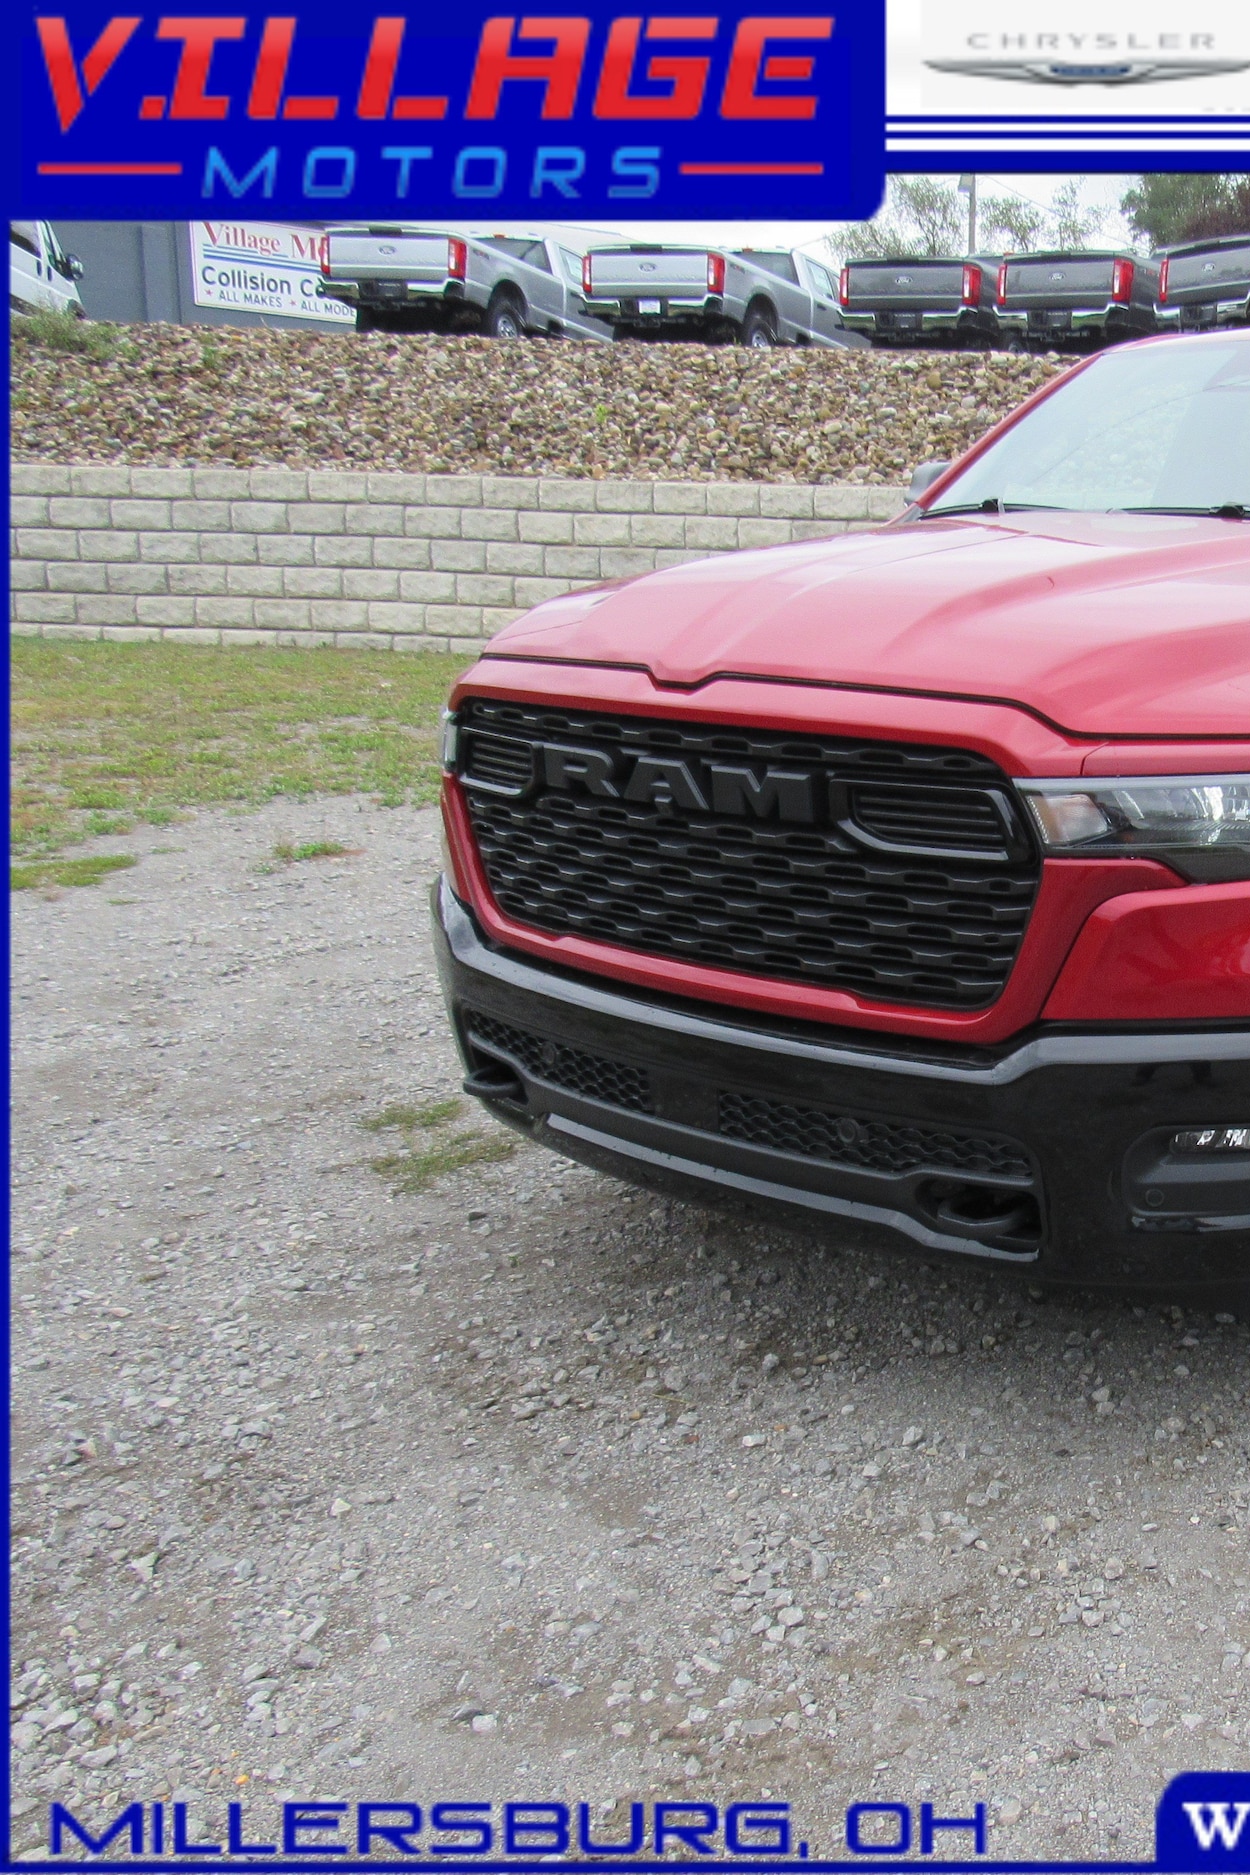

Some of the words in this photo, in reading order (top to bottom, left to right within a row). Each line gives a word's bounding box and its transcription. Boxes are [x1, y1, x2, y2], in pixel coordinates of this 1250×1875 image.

[202, 221, 281, 256] Village
[201, 266, 292, 295] Collision
[219, 289, 240, 303] ALL
[244, 293, 283, 308] MAKES
[301, 300, 320, 313] ALL
[542, 741, 814, 823] RAM
